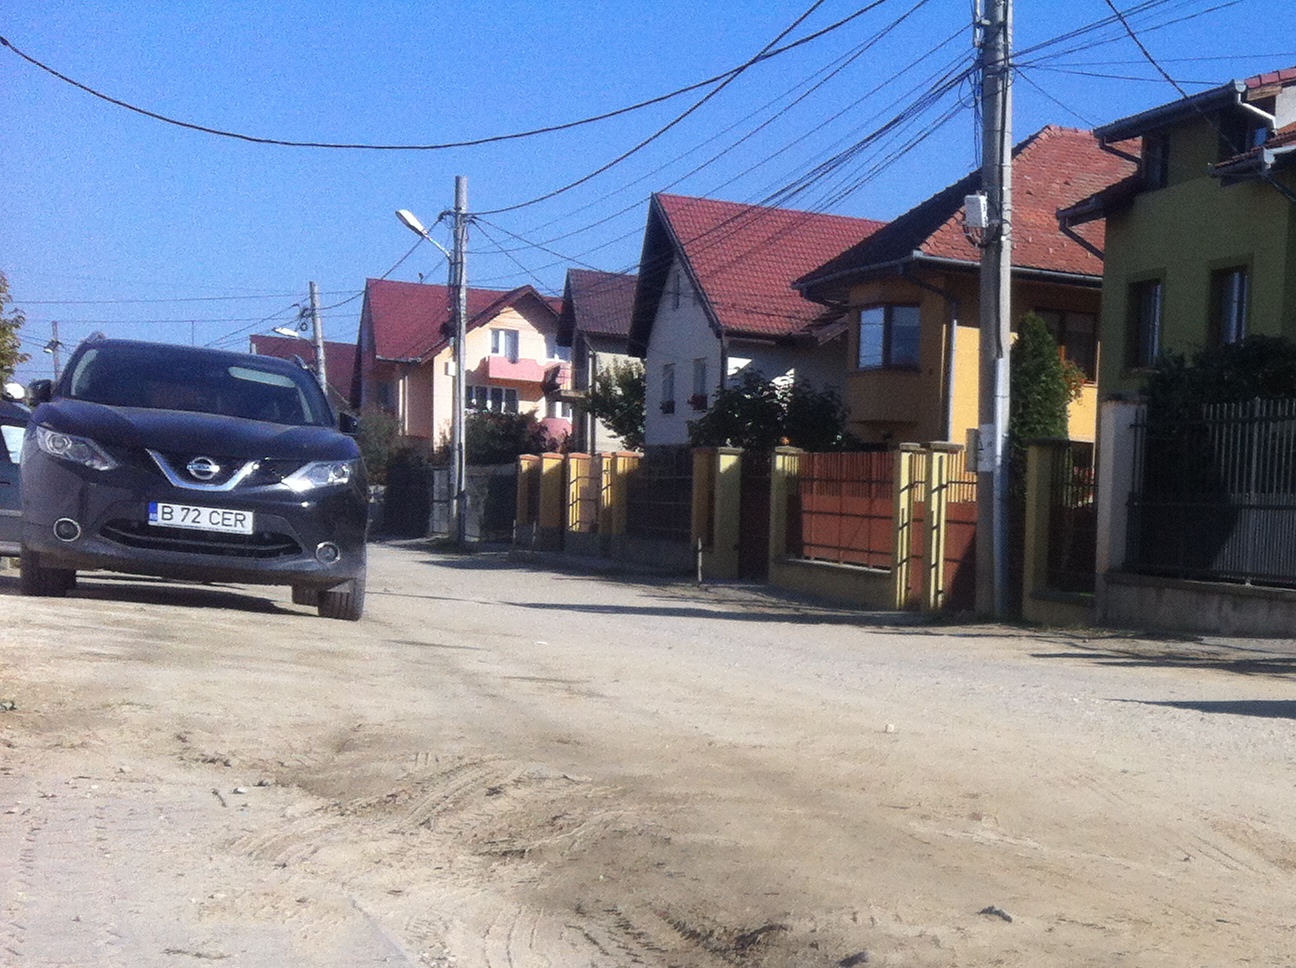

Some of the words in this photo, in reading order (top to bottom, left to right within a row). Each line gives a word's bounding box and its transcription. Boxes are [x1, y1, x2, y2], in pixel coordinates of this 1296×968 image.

[161, 505, 174, 521] B
[180, 507, 201, 524] 72
[208, 510, 247, 528] CER
